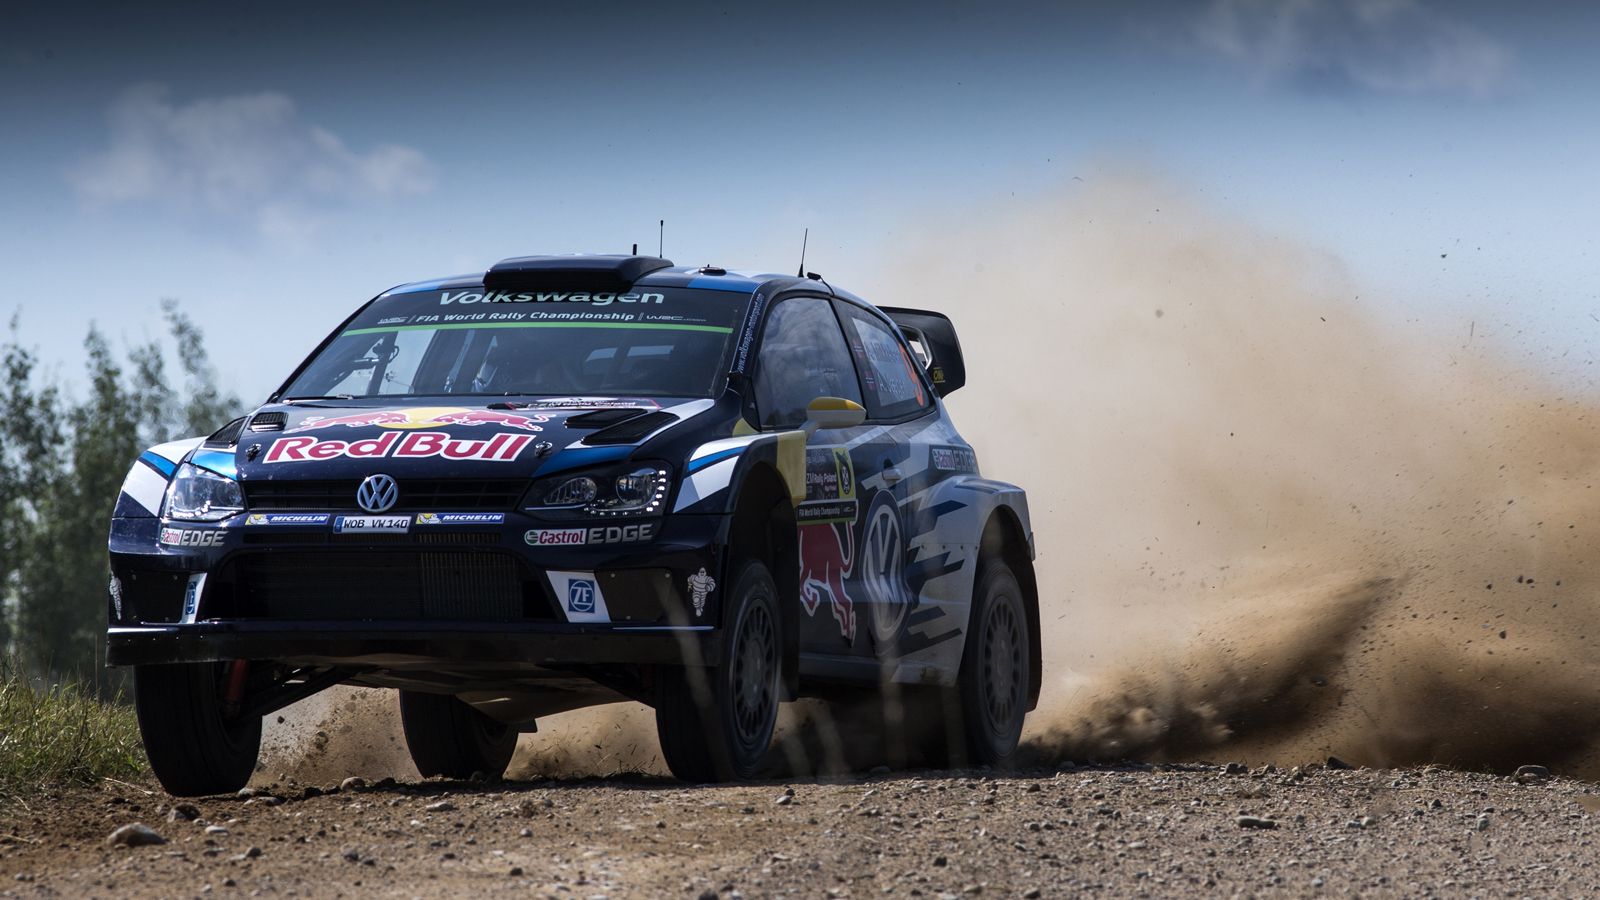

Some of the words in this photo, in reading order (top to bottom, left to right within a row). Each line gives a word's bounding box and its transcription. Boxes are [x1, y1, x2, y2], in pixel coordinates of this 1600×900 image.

[440, 290, 665, 306] Volkswagen
[416, 315, 439, 323] FIA
[444, 313, 486, 322] World
[489, 312, 527, 321] Rally
[530, 311, 636, 322] Championship
[265, 433, 397, 462] Red
[396, 433, 535, 462] Bull
[270, 514, 327, 523] MICHELIN
[343, 519, 366, 529] WOB
[442, 513, 504, 522] MICHELIN
[181, 530, 228, 547] EDGE
[539, 530, 585, 545] Castrol
[588, 524, 653, 544] EDGE
[571, 586, 593, 606] ZF
